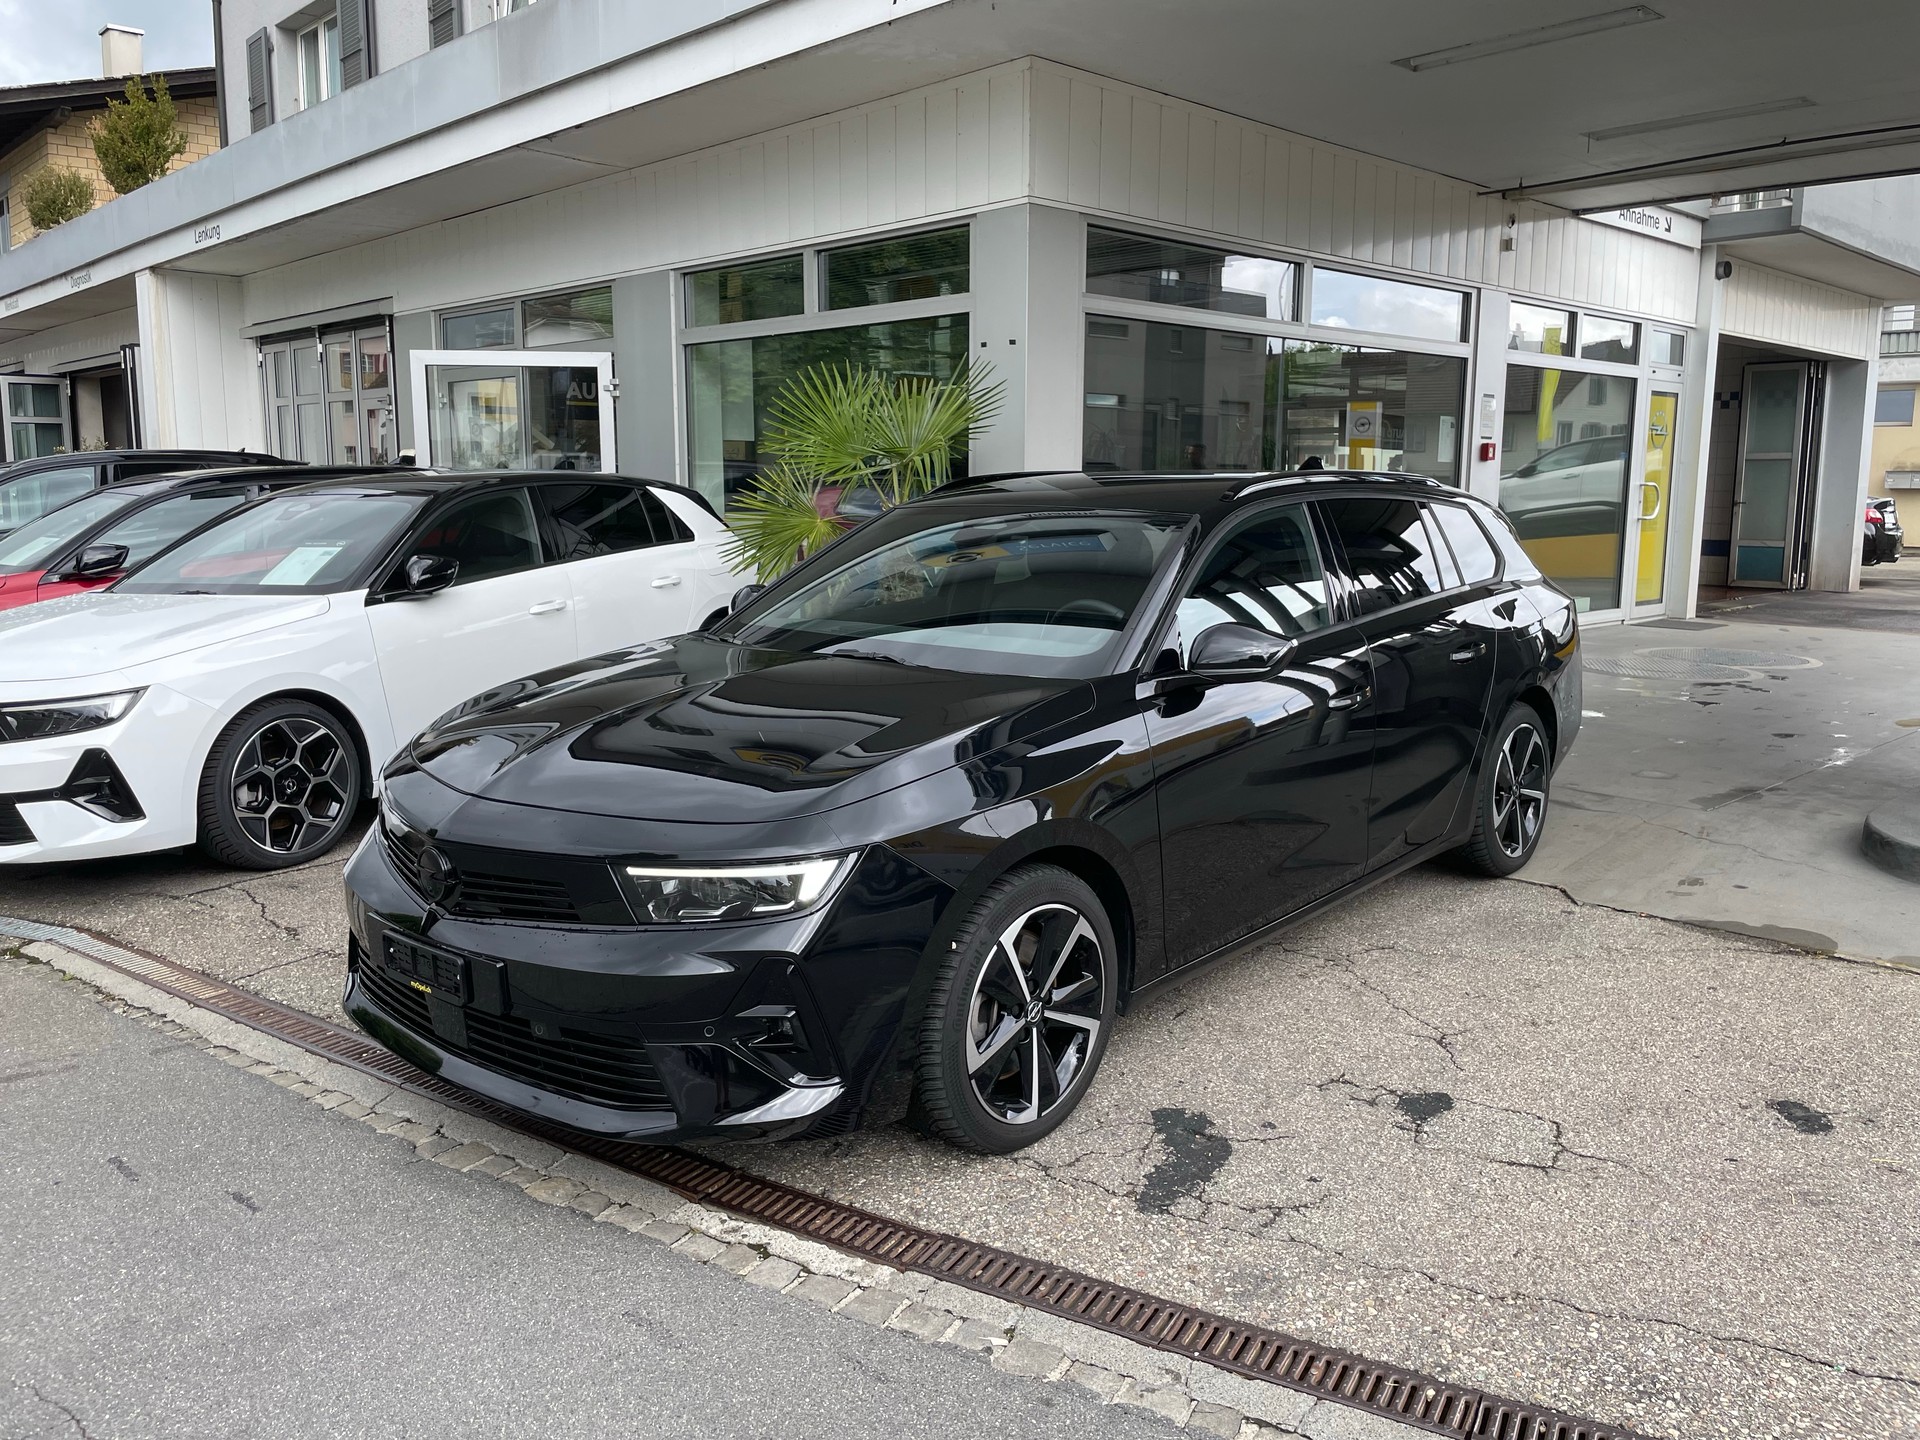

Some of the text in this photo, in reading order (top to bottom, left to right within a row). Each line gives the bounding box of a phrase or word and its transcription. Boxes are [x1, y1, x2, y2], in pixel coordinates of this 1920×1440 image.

[1618, 209, 1660, 230] Annahme
[194, 225, 221, 244] Lenkung
[70, 271, 92, 289] Diagnostik
